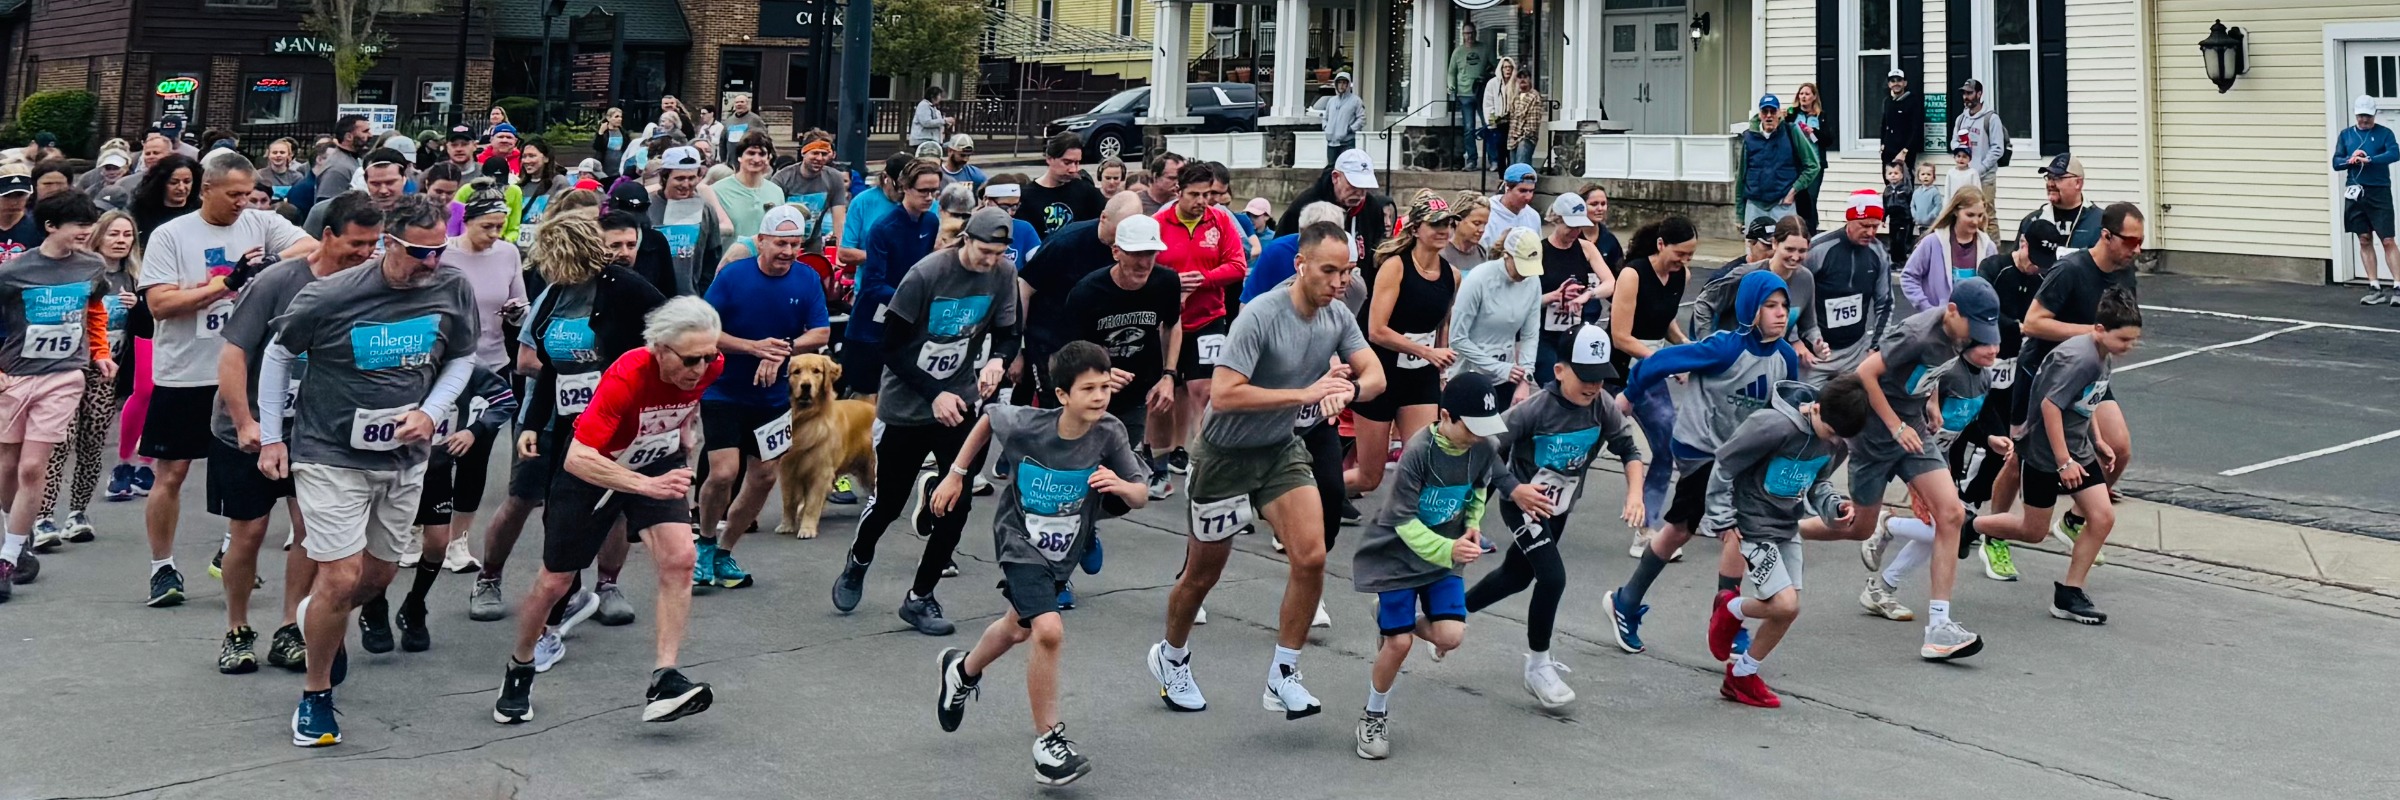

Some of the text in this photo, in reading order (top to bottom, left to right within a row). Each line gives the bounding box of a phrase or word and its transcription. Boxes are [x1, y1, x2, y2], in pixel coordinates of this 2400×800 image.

[289, 37, 316, 52] AN
[158, 80, 194, 93] OPEN
[36, 288, 79, 305] Allergy
[1097, 311, 1156, 330] FRONTIER
[1833, 305, 1857, 321] 755
[370, 326, 423, 347] Allergy
[549, 320, 583, 343] Allergy
[35, 336, 72, 352] 715
[926, 353, 960, 372] 762
[1992, 368, 2011, 382] 791
[560, 386, 593, 407] 829
[766, 423, 792, 451] 878
[628, 446, 670, 465] 815
[1031, 472, 1082, 495] Allergy
[1199, 510, 1238, 535] 771
[1037, 531, 1075, 552] 868
